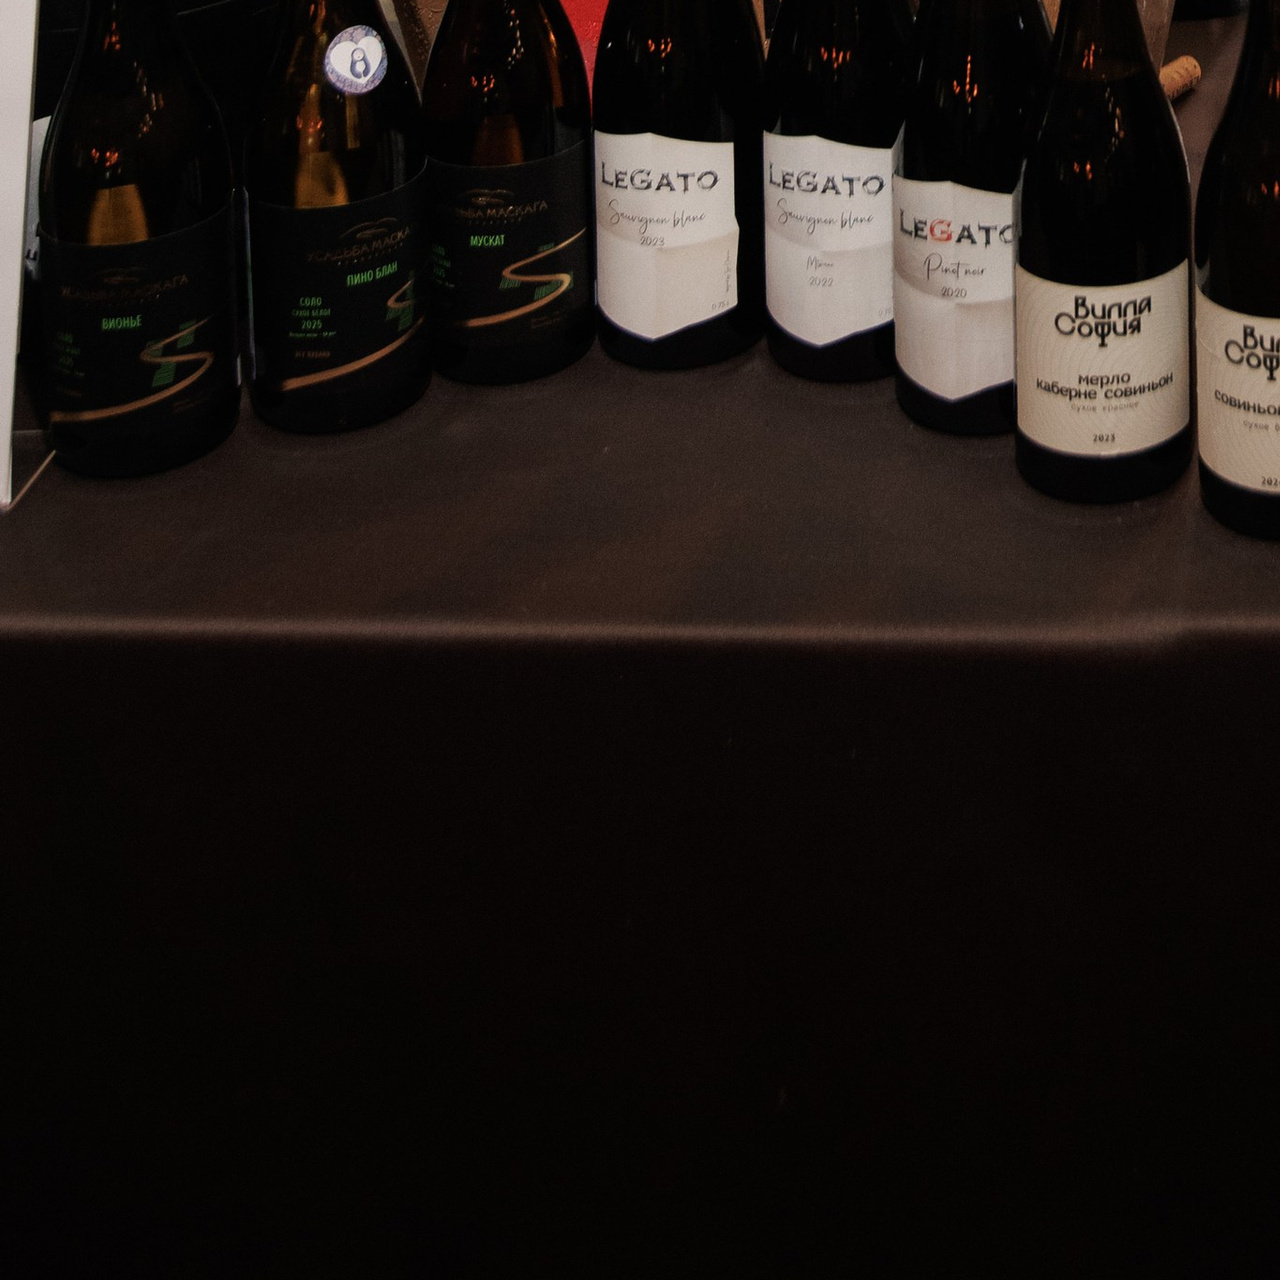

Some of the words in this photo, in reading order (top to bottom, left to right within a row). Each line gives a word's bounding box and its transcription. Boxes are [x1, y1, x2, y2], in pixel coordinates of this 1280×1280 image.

[601, 161, 721, 195] LEGATO
[768, 160, 886, 197] LEGATO
[609, 199, 670, 234] Sauvignon
[672, 210, 706, 228] blanc
[776, 198, 838, 235] Sauvignon
[840, 211, 874, 229] blanc
[470, 234, 506, 247] МУСКАТ
[640, 236, 665, 247] 2023
[346, 270, 374, 288] ПИНО
[375, 261, 399, 280] БЛАН
[924, 252, 970, 281] Pinot
[964, 265, 987, 277] noir
[809, 276, 834, 288] 2022
[941, 286, 968, 299] 2020
[299, 296, 322, 307] СОЛО
[1075, 295, 1151, 320] Вилла
[101, 314, 143, 331] ВИОНЬЕ
[1055, 312, 1141, 348] София
[1036, 377, 1097, 401] каберне
[1104, 372, 1174, 399] совиньон
[1078, 373, 1131, 388] мерло
